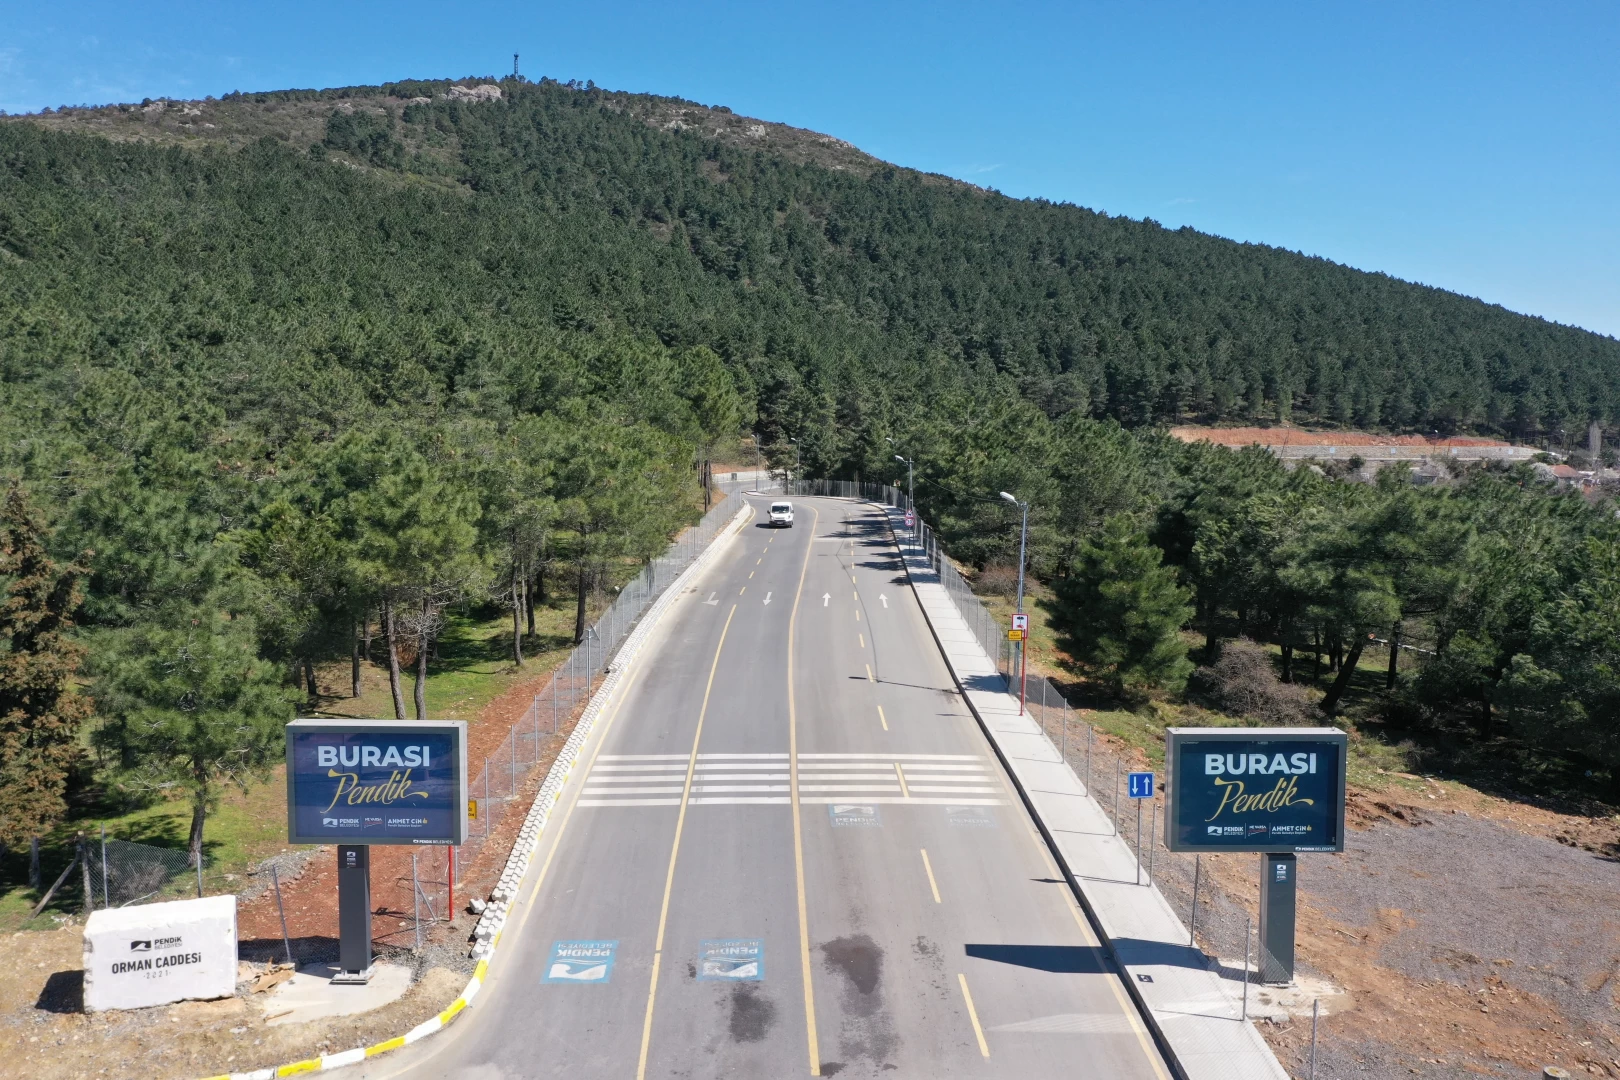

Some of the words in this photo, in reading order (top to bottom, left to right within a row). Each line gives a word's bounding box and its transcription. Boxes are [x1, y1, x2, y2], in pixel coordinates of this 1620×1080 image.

[318, 745, 430, 767] BURASI
[1204, 752, 1317, 775] BURASI
[319, 768, 429, 814] Pendik
[1204, 775, 1314, 822] Pendik
[111, 958, 152, 975] ORMAN
